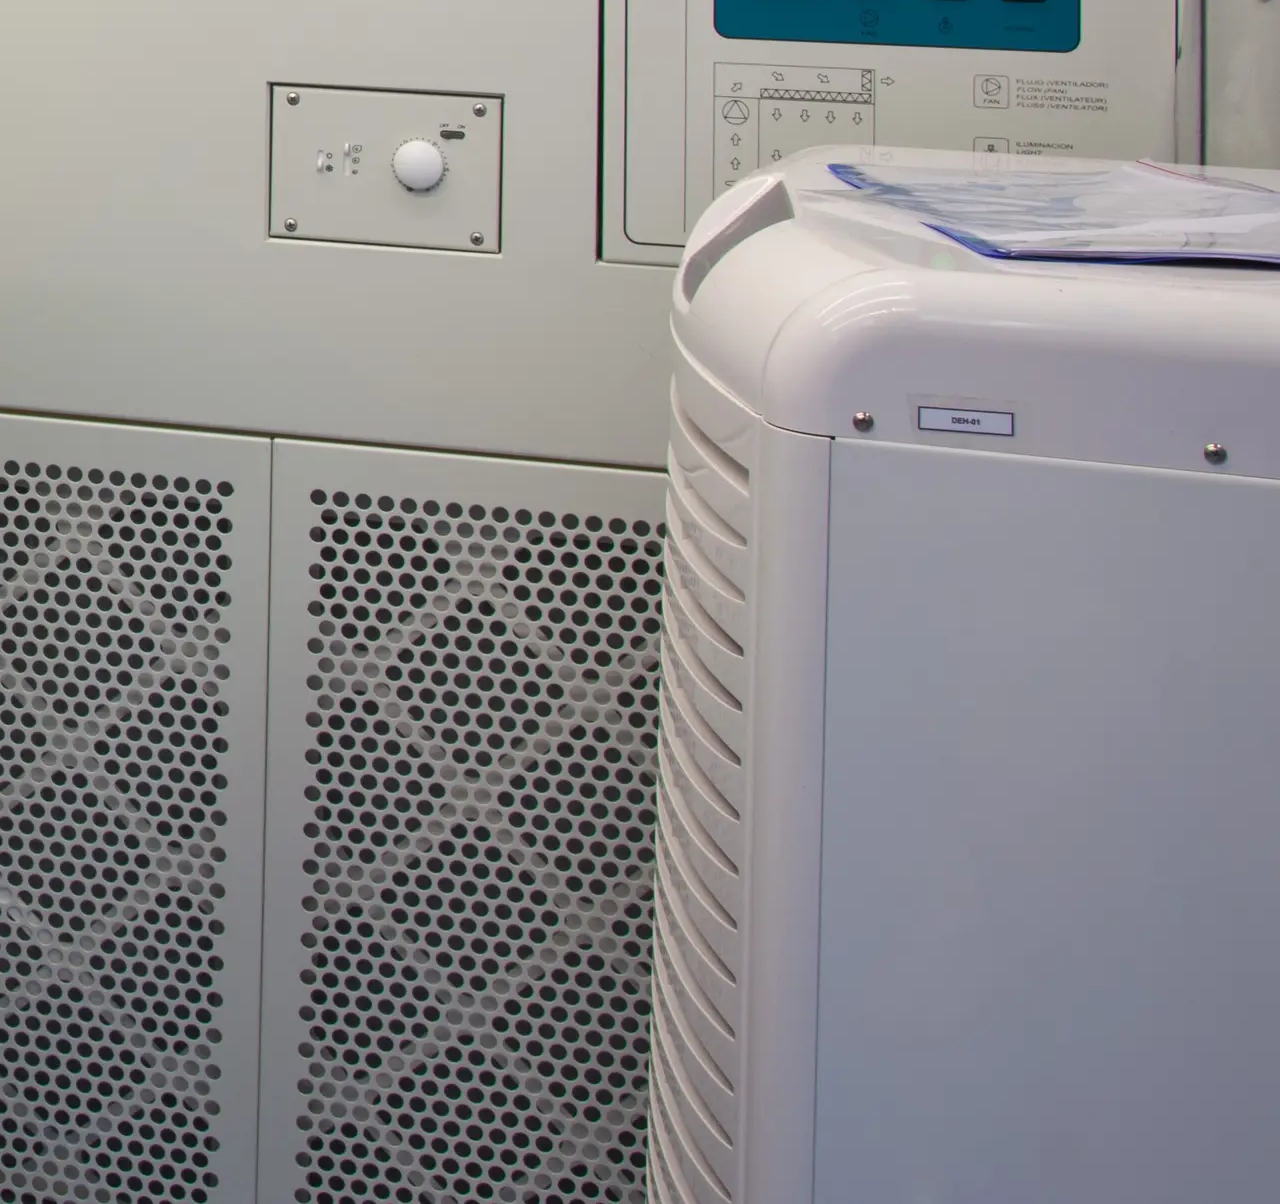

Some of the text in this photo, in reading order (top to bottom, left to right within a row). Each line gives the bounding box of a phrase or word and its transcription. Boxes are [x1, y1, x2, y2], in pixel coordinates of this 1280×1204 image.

[1046, 80, 1109, 89] (VENTILADOR)
[1040, 95, 1107, 104] (VENTILATEUR)
[1047, 103, 1108, 112] (VENTILATOR)
[951, 417, 981, 425] DEH-01
